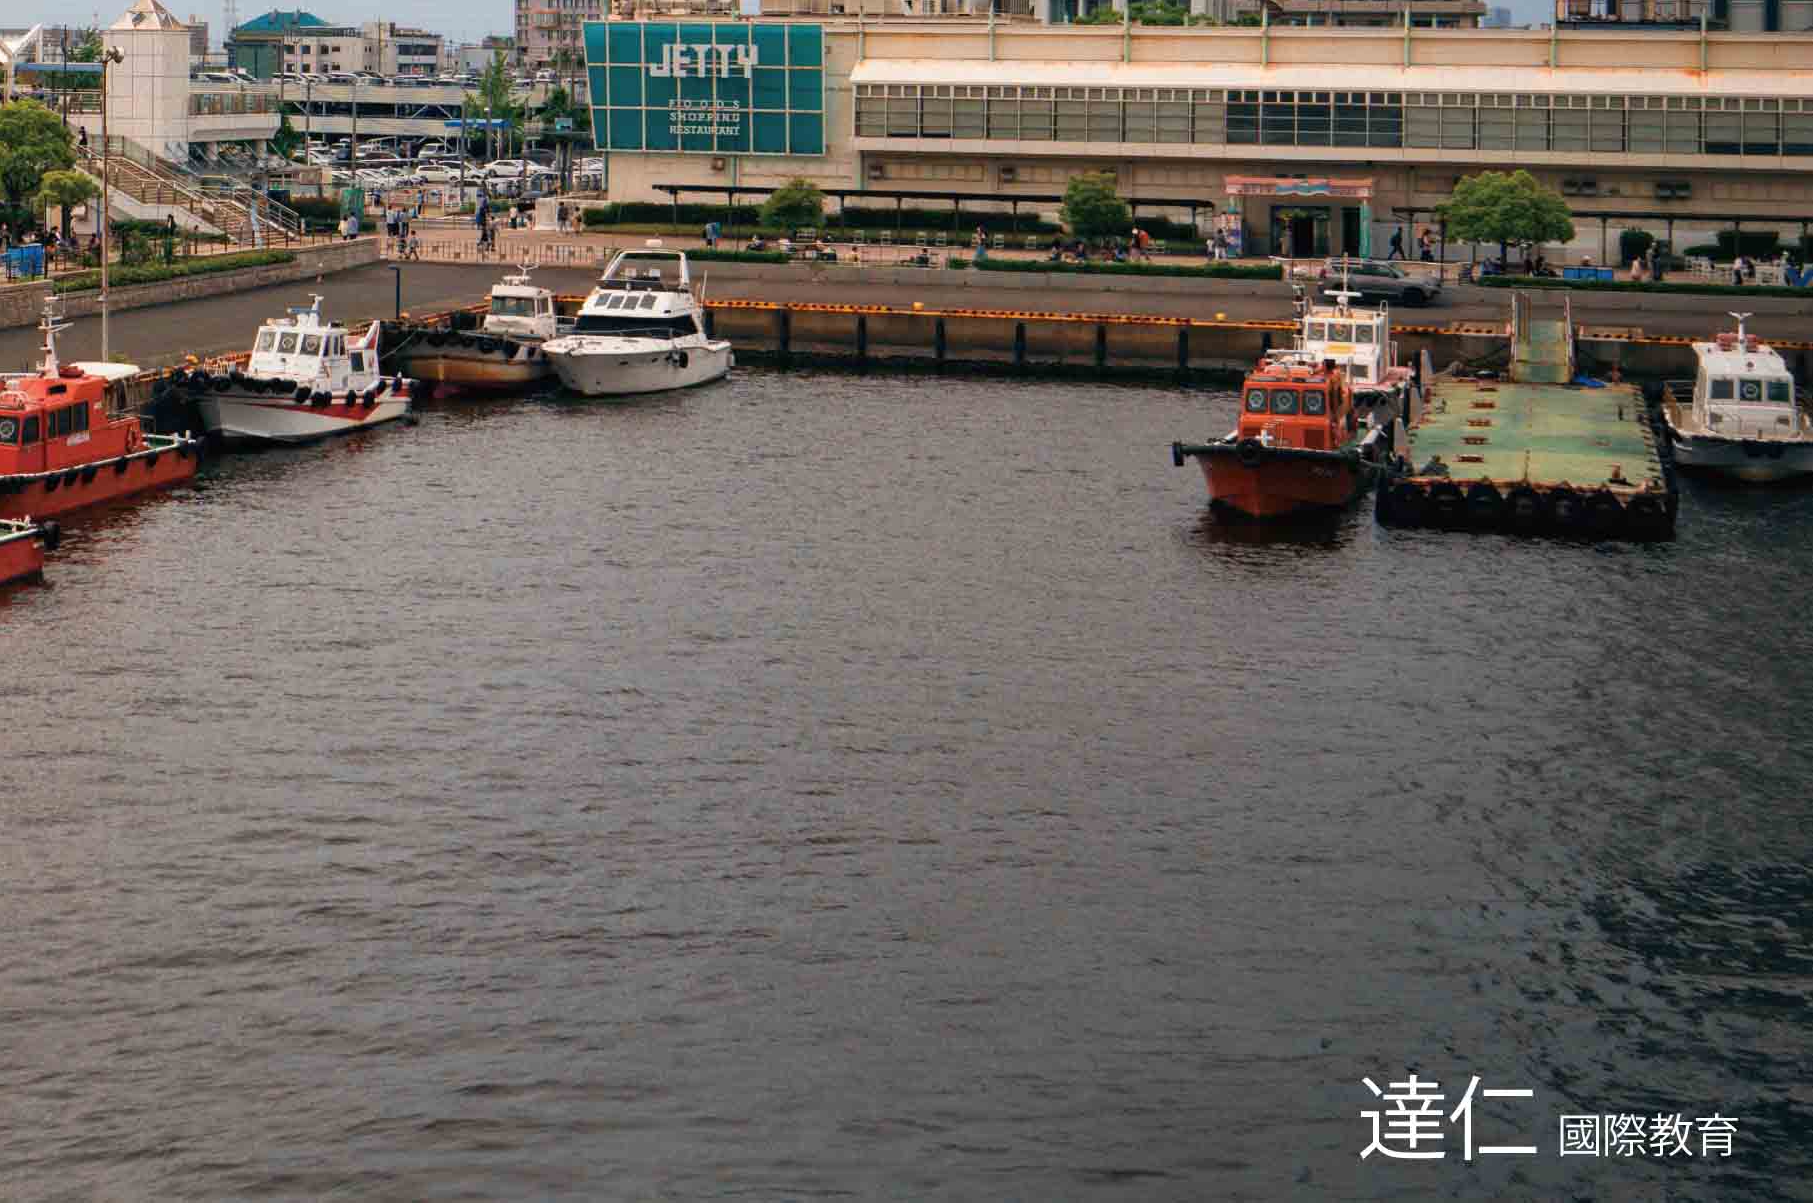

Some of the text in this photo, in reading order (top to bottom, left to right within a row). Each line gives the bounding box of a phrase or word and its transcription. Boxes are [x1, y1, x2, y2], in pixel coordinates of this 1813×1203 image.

[649, 44, 759, 79] JETTY
[668, 112, 741, 122] SHOPPING
[668, 125, 741, 136] RESTAURANT
